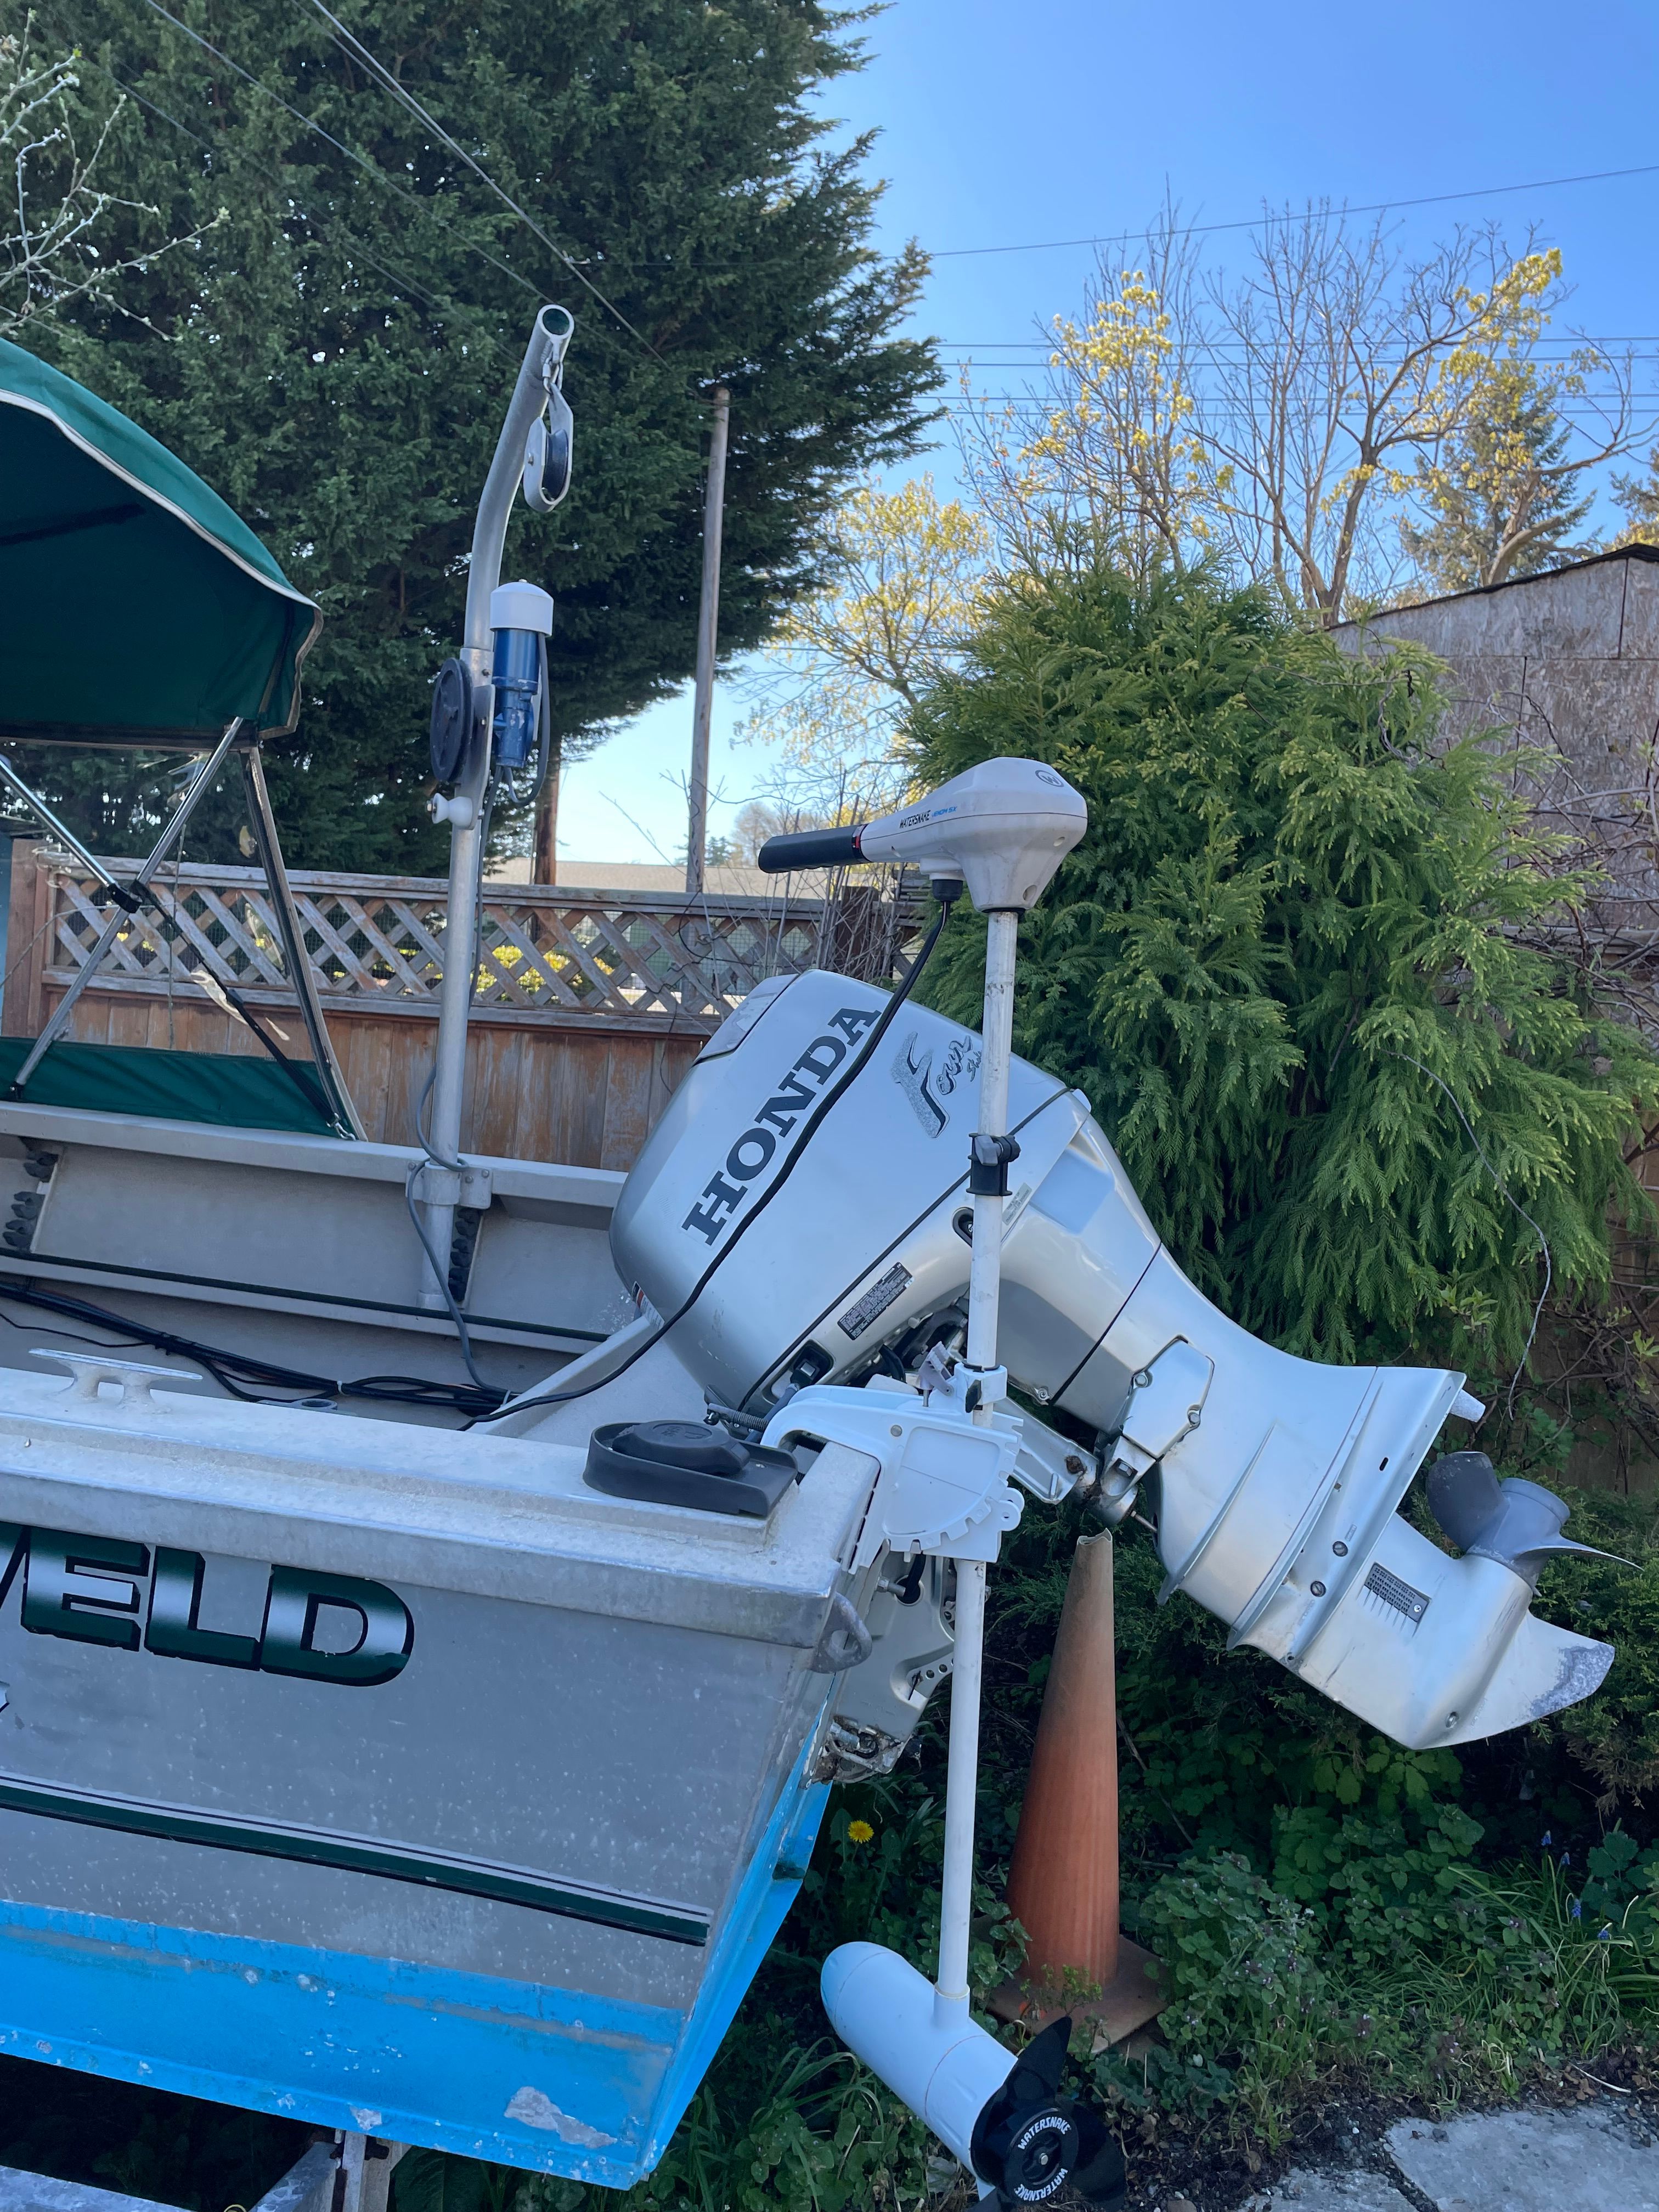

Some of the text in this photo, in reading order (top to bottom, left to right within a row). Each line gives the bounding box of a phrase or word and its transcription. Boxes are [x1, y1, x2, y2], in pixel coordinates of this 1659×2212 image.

[899, 809, 931, 829] WATERSNAKE
[681, 1007, 882, 1246] HONDA
[1017, 2115, 1071, 2151] WATERSNAKE
[1013, 2167, 1069, 2202] WATERSNAKE
